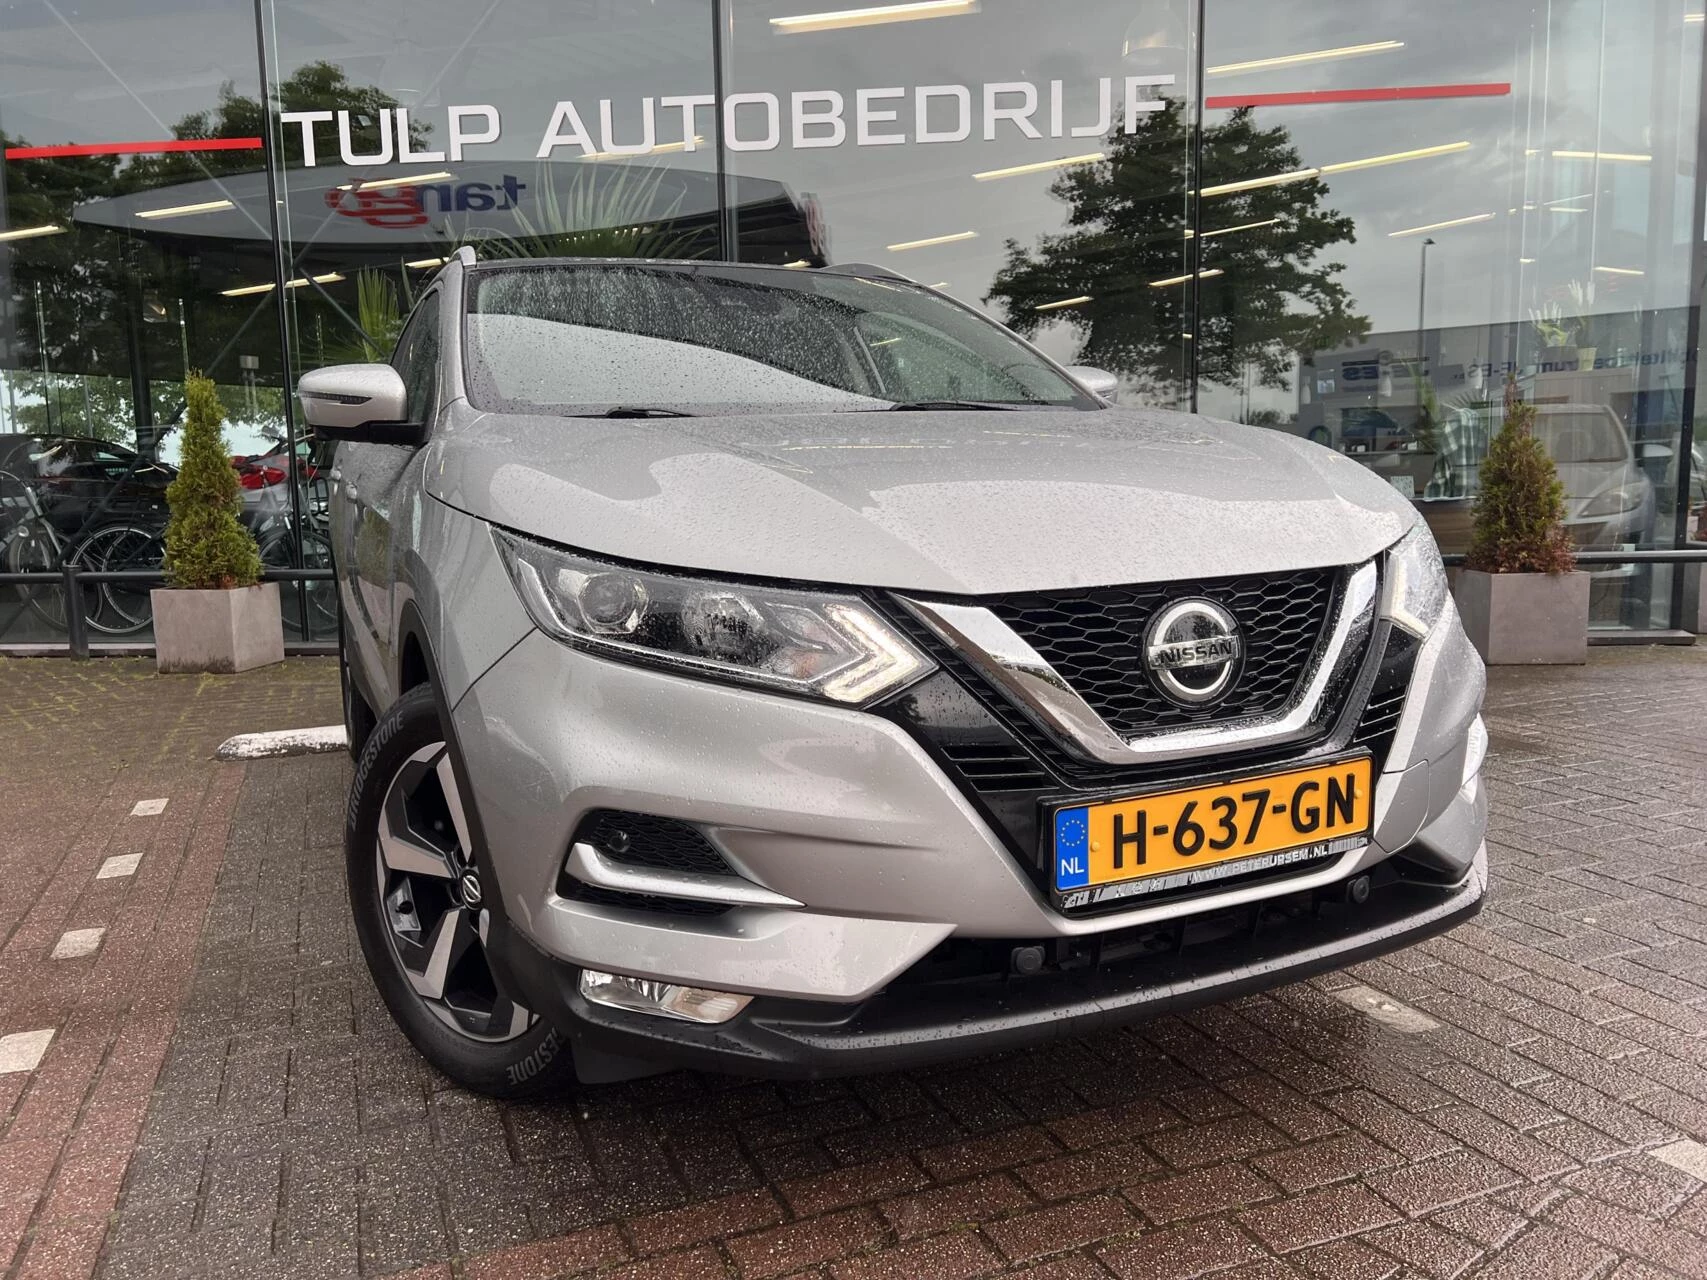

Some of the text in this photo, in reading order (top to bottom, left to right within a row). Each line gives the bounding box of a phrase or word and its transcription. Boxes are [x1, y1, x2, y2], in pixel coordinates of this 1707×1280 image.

[281, 74, 1176, 168] TULP AUTOBEDRIJF
[1159, 640, 1232, 664] NISSAN
[348, 709, 404, 833] BRIDGESTONE
[1060, 857, 1085, 876] NL
[1113, 773, 1355, 869] H-637-GN
